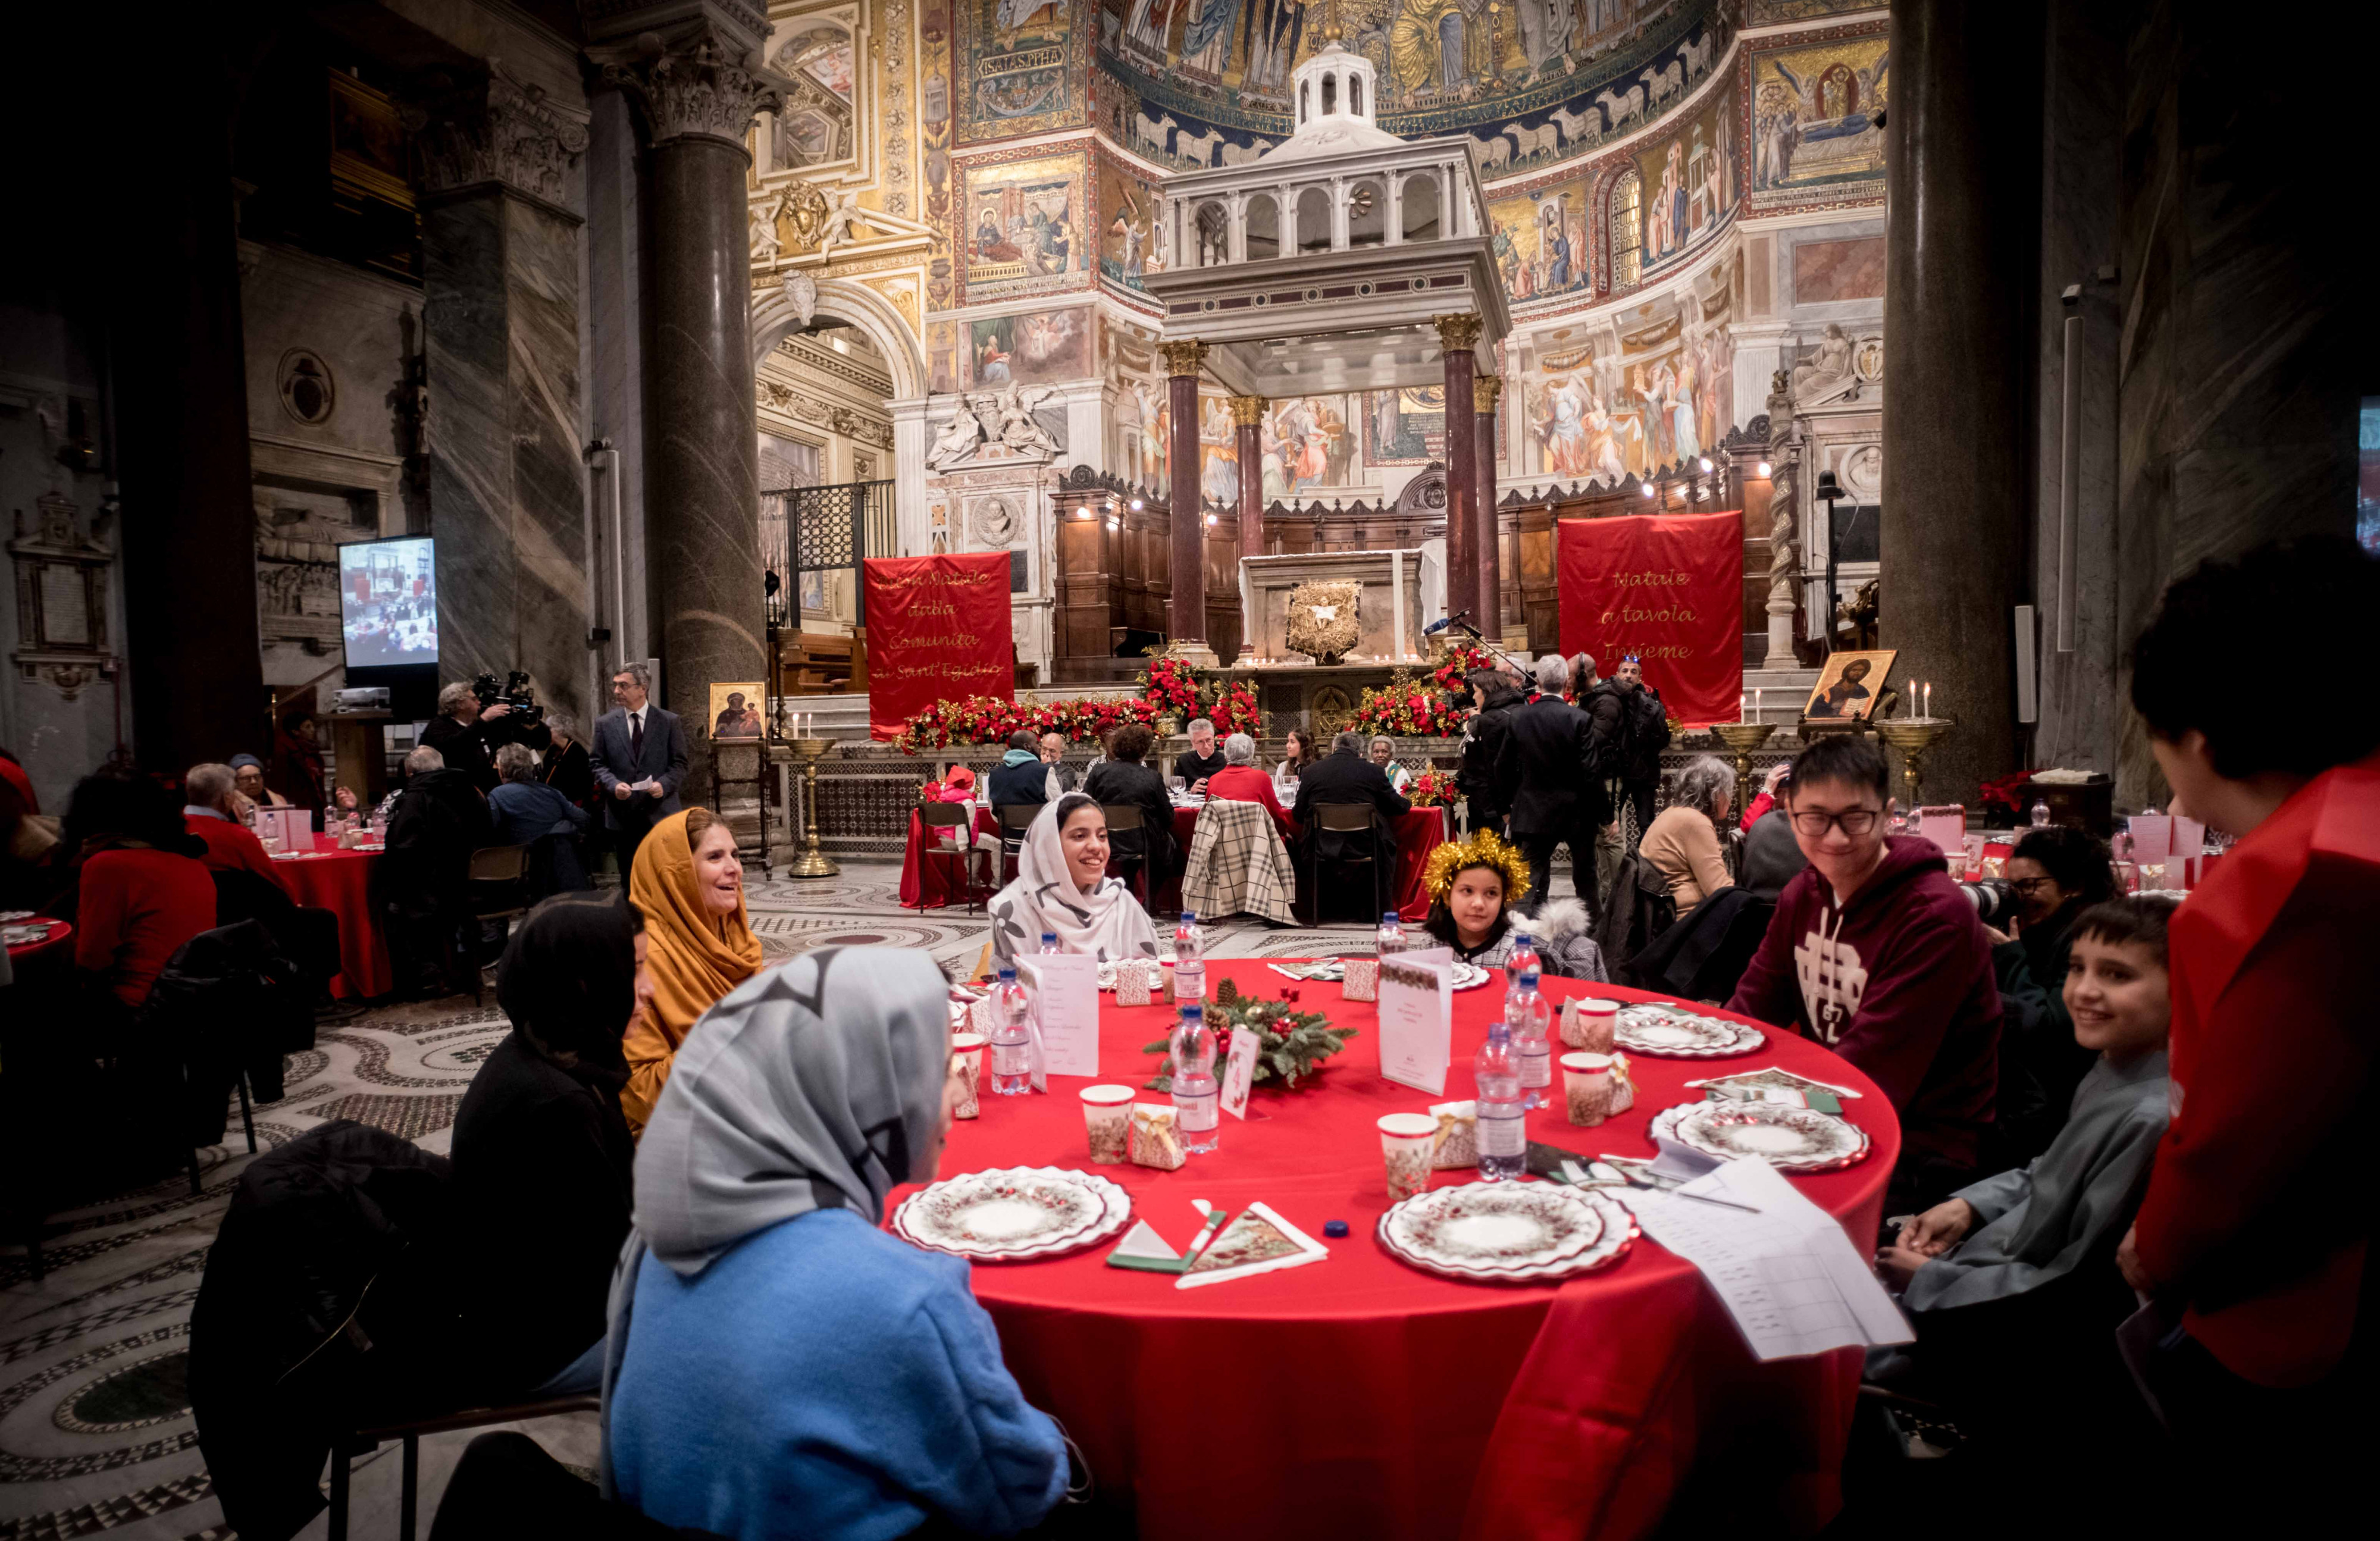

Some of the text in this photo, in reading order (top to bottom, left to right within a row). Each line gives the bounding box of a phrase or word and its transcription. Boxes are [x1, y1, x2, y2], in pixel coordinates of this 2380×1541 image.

[929, 569, 993, 586] Natale
[1614, 569, 1690, 587] Natale
[1601, 605, 1696, 625] a tavola
[1604, 643, 1695, 660] Insieme
